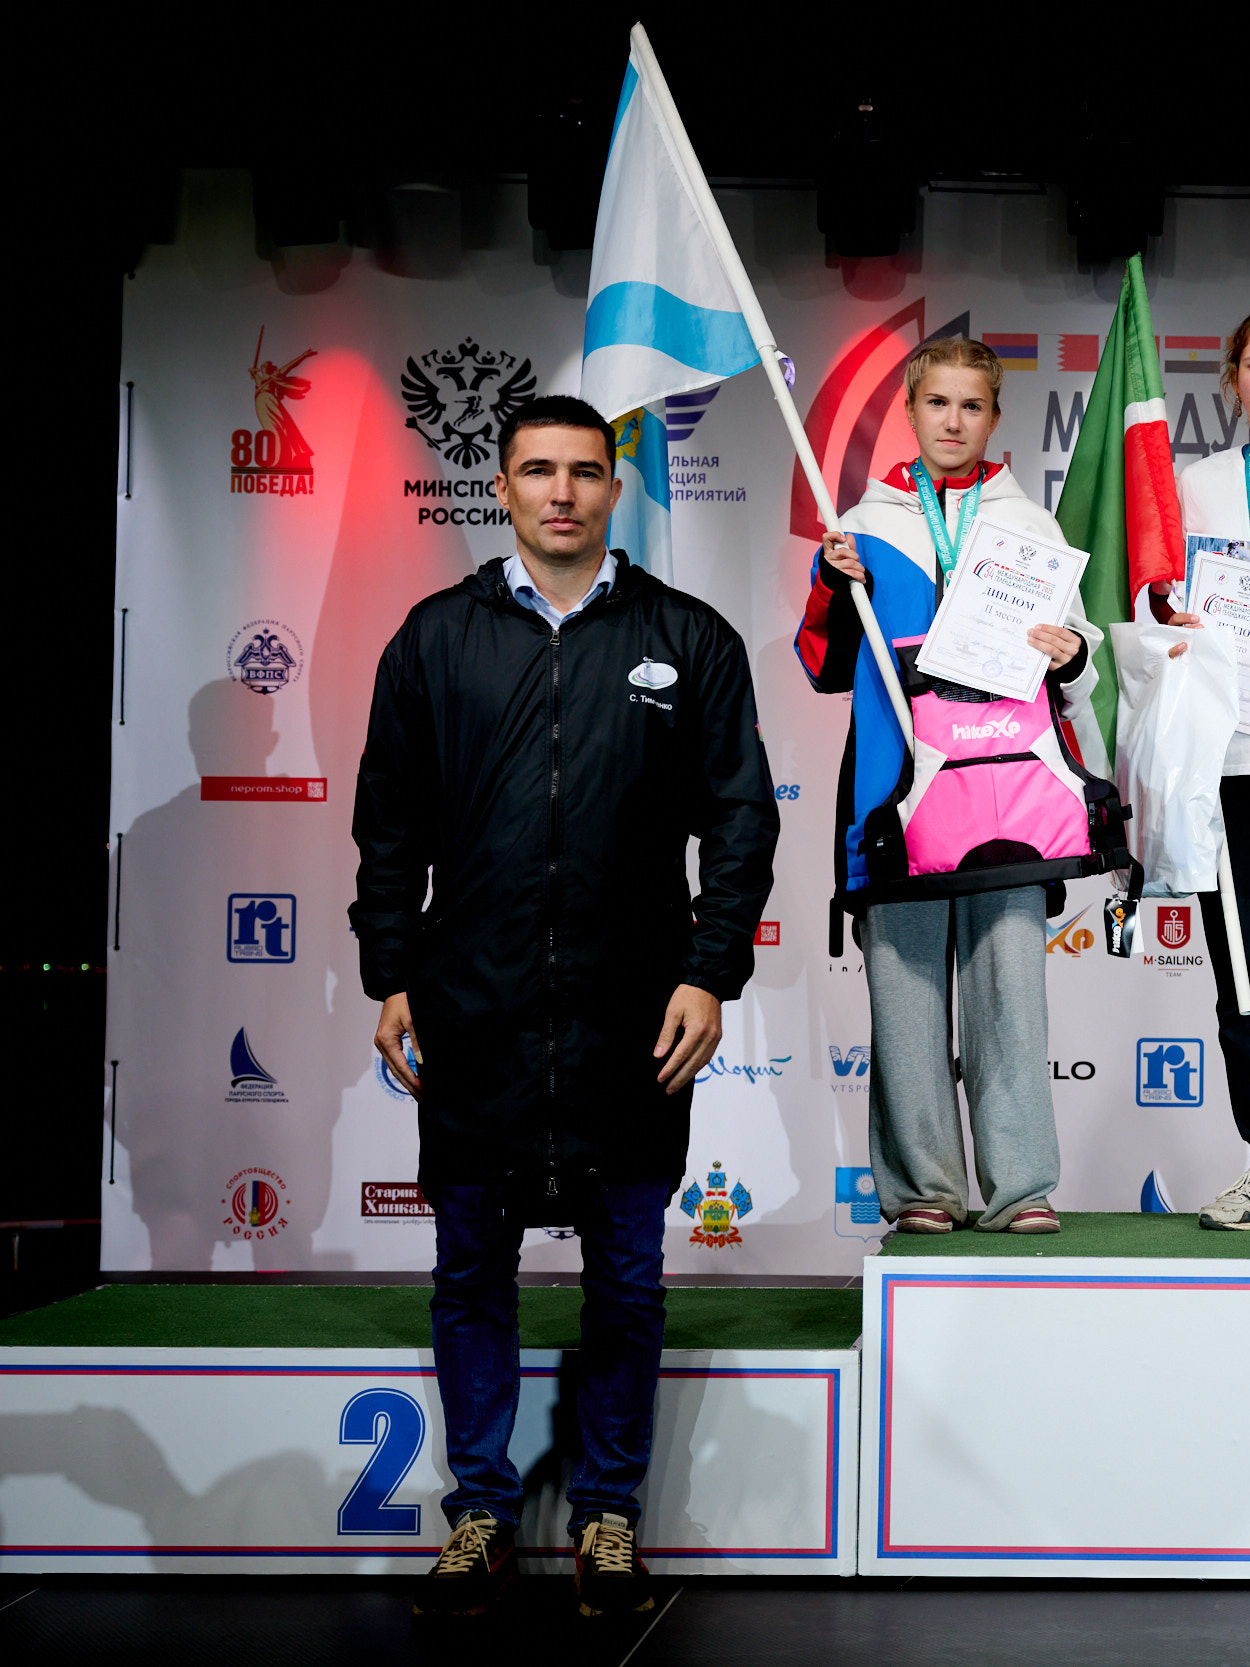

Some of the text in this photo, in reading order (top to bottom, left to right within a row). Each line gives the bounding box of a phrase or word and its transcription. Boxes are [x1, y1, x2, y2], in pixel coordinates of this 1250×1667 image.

[231, 429, 276, 467] 80
[230, 474, 314, 497] ПОБЕДА!
[404, 480, 497, 498] МИНСПО
[981, 586, 1035, 611] ДИПЛОМ
[249, 670, 282, 678] ВФПС
[231, 785, 303, 795] neprom.shop
[226, 1167, 286, 1190] СПОРТОБЩЕСТВО
[364, 1185, 418, 1201] Старик
[223, 1217, 288, 1241] РОССИЯ
[337, 1388, 426, 1536] 2
